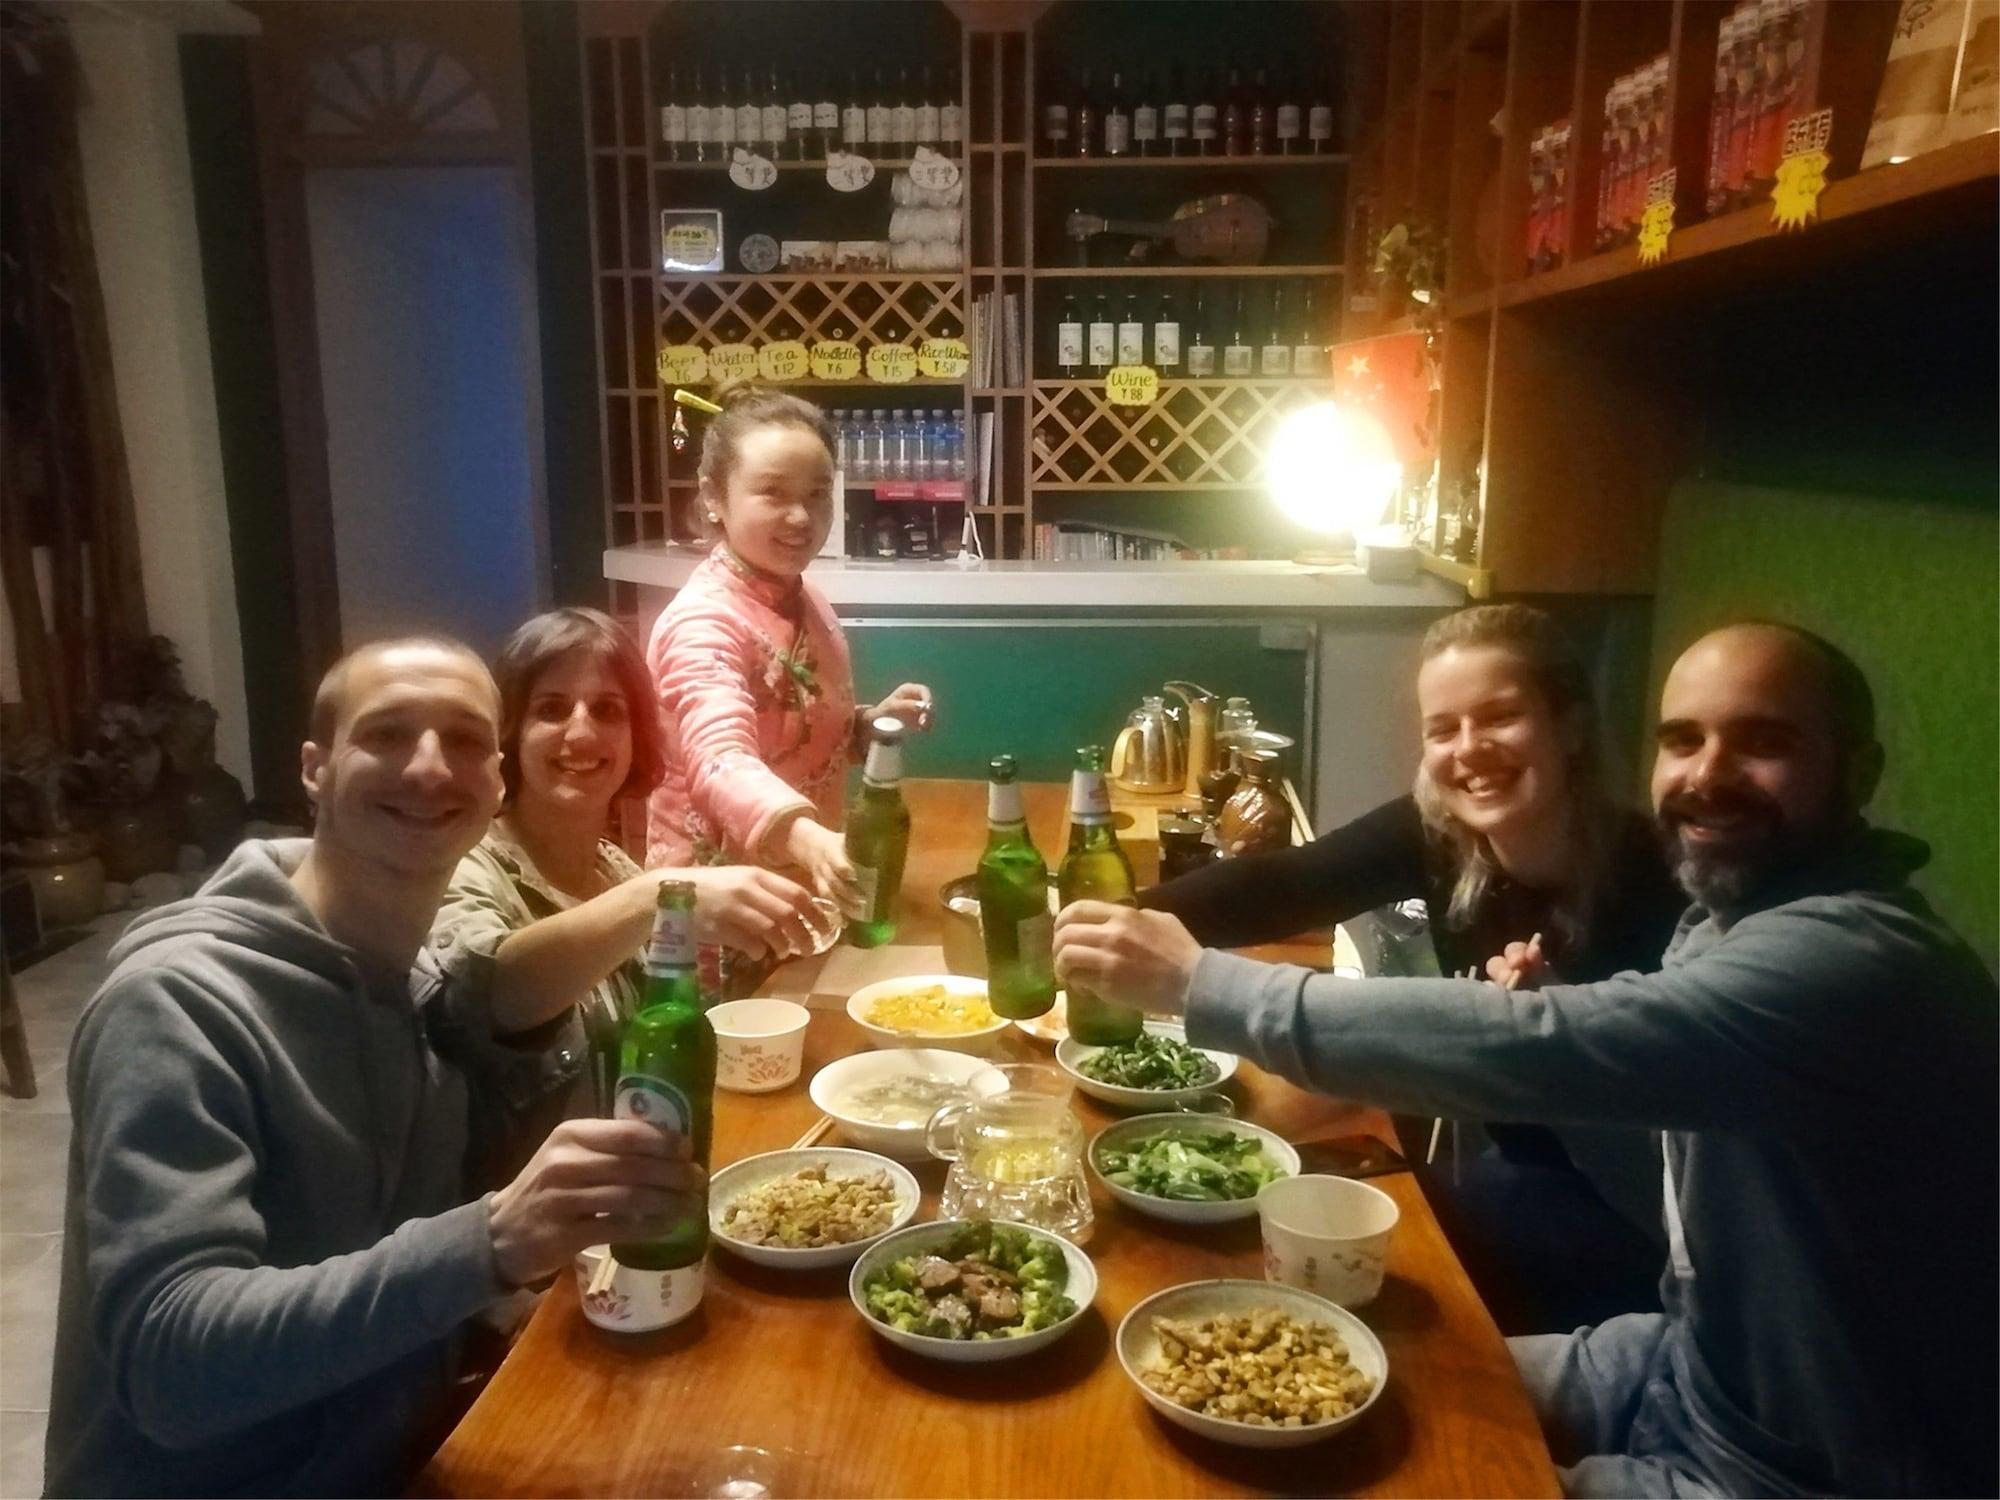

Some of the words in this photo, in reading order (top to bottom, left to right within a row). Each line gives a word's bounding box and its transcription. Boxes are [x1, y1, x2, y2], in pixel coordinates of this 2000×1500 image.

[660, 351, 698, 369] Beer
[709, 351, 754, 366] Water
[767, 349, 799, 362] Tea
[871, 347, 915, 363] Coffee
[1111, 372, 1152, 387] Wine
